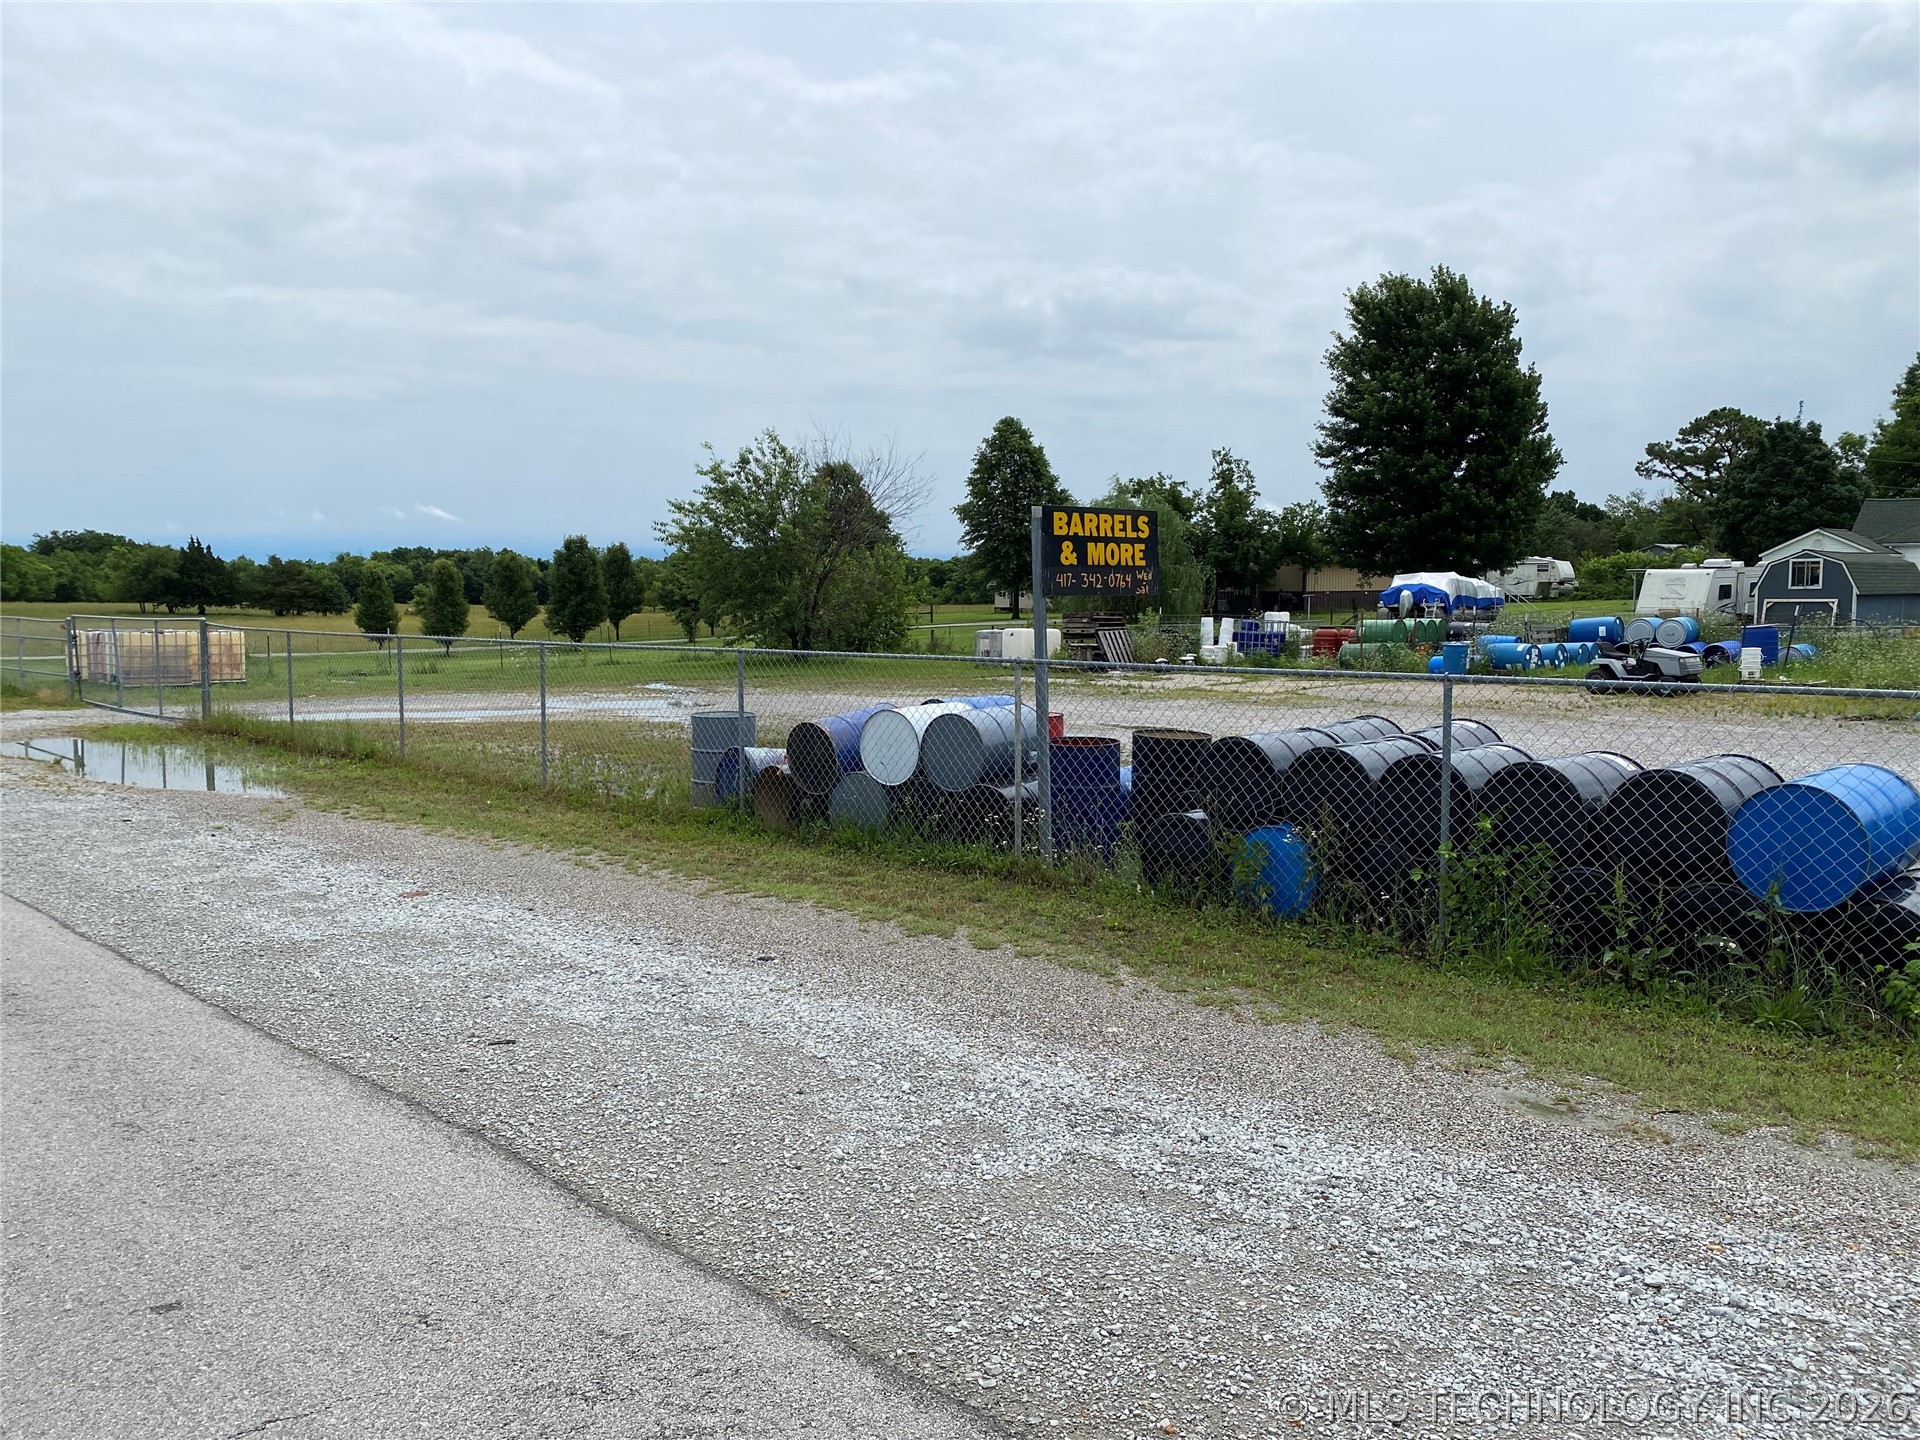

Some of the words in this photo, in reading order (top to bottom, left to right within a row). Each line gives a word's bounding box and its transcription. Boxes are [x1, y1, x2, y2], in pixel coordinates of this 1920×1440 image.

[1053, 511, 1150, 539] BARRELS
[1060, 540, 1078, 566] &
[1087, 542, 1146, 566] MORE
